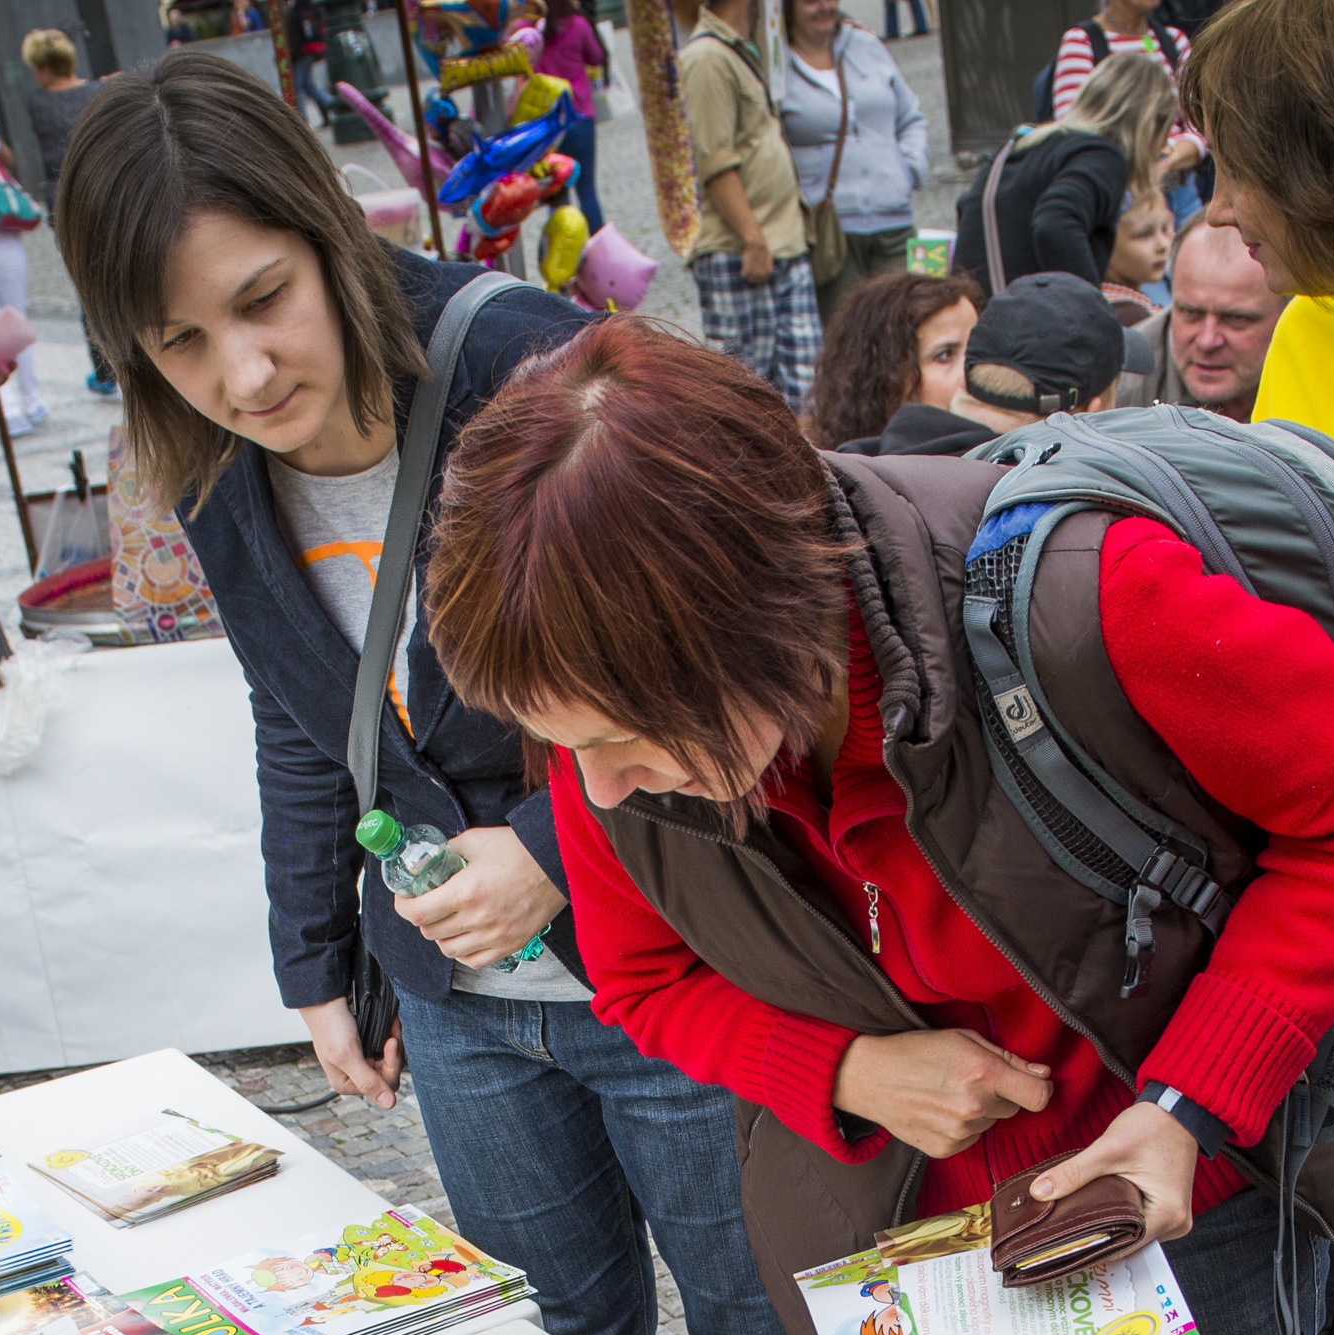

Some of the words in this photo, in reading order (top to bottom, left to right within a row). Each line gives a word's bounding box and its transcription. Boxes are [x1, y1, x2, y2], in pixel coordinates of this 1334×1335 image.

[1013, 717, 1037, 734] deuter
[955, 1283, 966, 1308] pomoci
[964, 1277, 979, 1315] plastového
[1094, 1259, 1115, 1312] zimní
[978, 1285, 993, 1324] magnetky
[1055, 1287, 1066, 1314] pomoc
[958, 1309, 969, 1333] zlepšit
